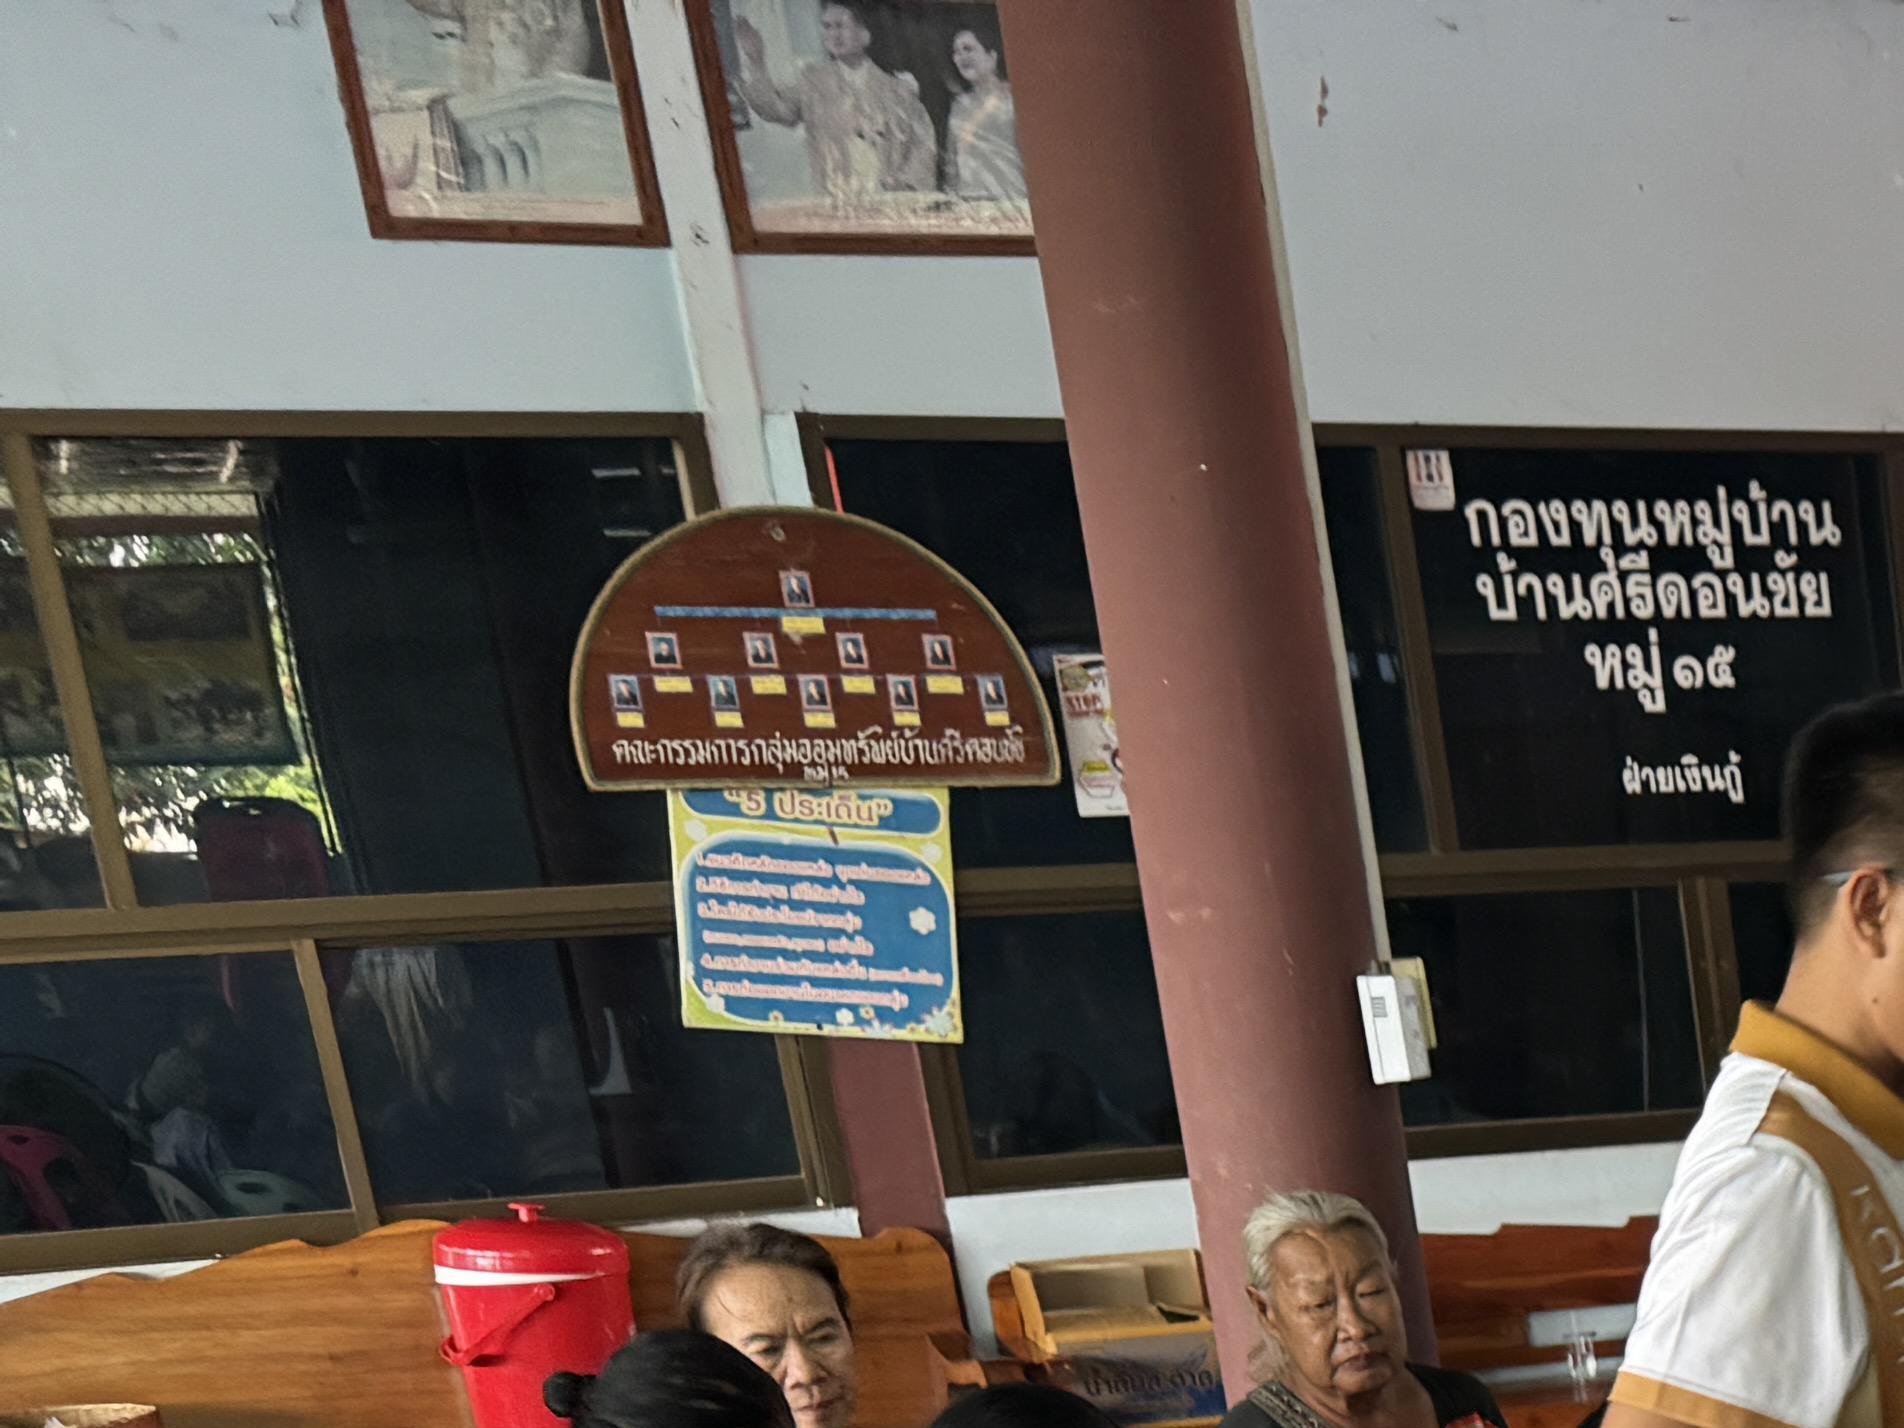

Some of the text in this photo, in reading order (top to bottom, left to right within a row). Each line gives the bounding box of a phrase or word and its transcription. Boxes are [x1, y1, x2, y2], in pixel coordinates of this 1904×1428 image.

[1464, 480, 1841, 568] กองทุนหมู่บ้าน
[1476, 554, 1832, 621] บ้านศรีดอนชัย
[1585, 628, 1736, 713] หมู่ ๑๕
[1622, 750, 1744, 804] ฝ่ายเงินกู้
